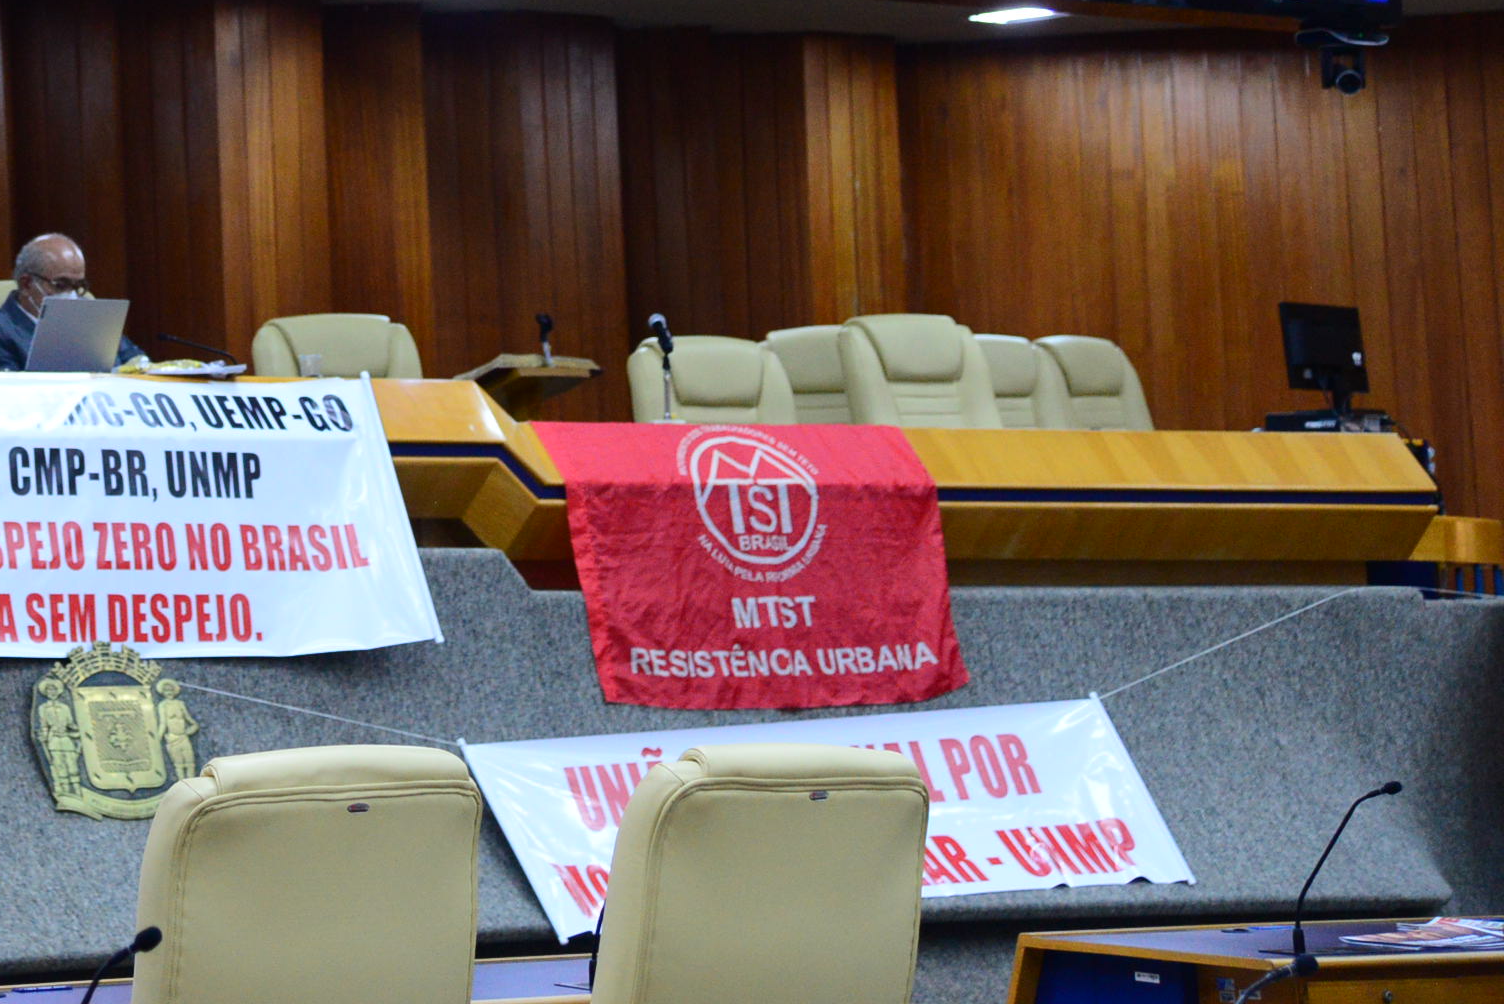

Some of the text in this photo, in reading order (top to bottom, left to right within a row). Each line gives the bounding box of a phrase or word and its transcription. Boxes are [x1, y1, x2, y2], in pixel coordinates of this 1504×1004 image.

[191, 393, 354, 432] UEMP-GO
[8, 446, 158, 502] CMP-BR,
[165, 449, 261, 499] UNMP
[93, 522, 177, 571] ZERO
[185, 522, 233, 572] NO
[239, 523, 370, 572] BRASIL
[25, 593, 96, 644] SEM
[108, 593, 263, 643] DESPEJO.
[731, 596, 816, 629] MTST
[630, 641, 939, 678] RESISTÊNCA URBANA
[939, 733, 1042, 800] POR
